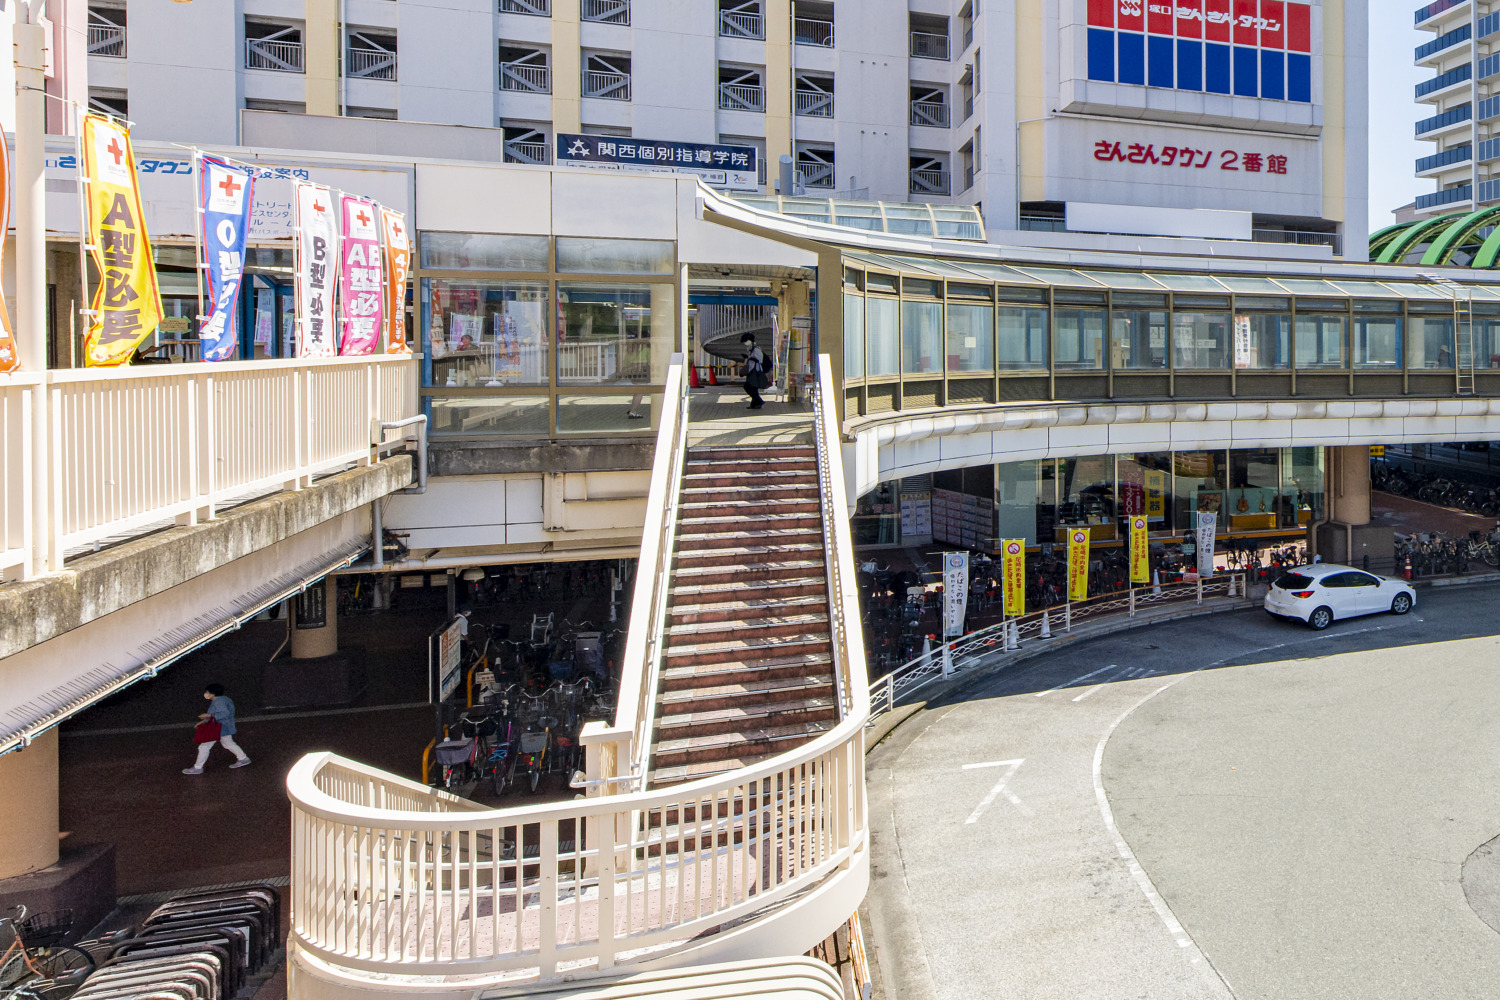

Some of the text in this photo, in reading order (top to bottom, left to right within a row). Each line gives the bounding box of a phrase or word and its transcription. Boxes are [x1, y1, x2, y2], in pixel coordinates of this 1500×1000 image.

[597, 142, 749, 167] 関西個別指導学院
[99, 192, 143, 346] A型必要
[309, 236, 327, 344] B型必要
